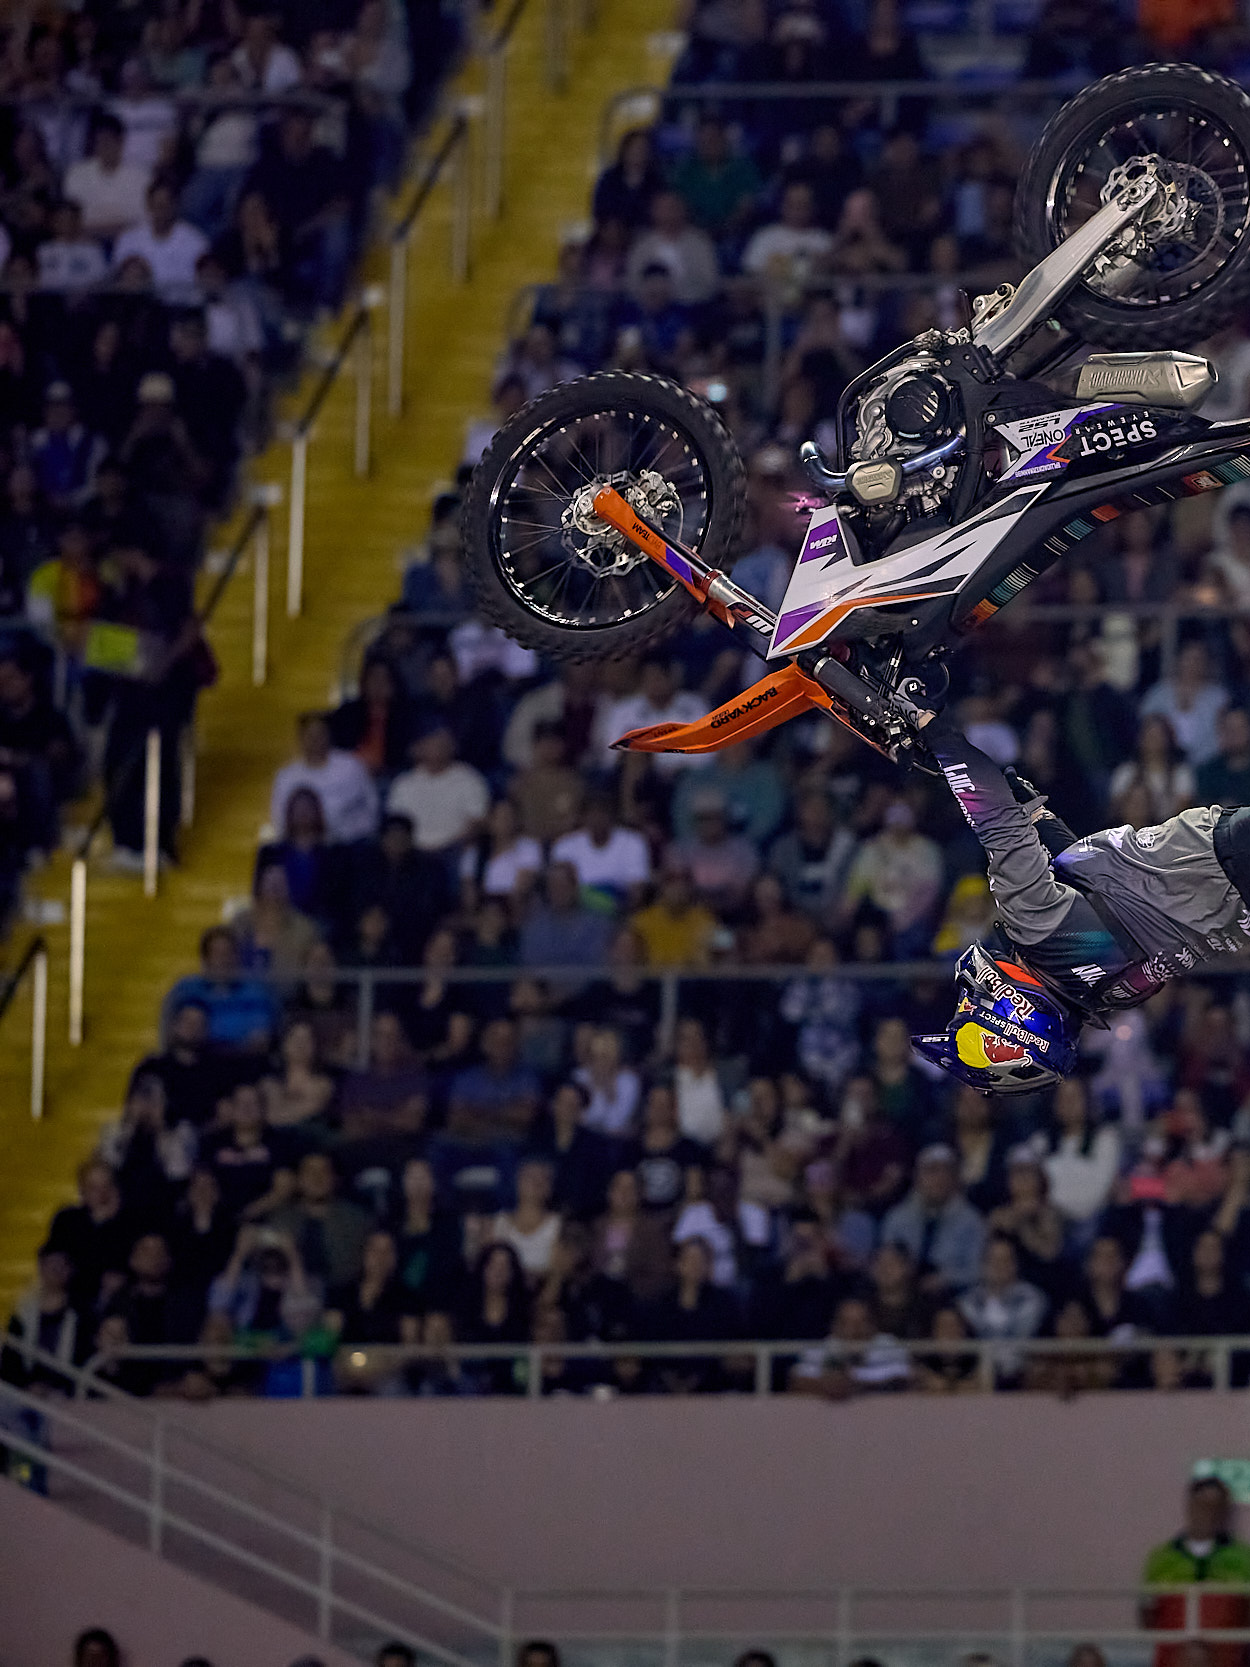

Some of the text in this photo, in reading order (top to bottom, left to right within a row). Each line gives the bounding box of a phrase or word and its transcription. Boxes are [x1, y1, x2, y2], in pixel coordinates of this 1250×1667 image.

[1080, 420, 1157, 457] SPECT
[809, 534, 838, 550] KTM
[710, 686, 778, 729] BACKYARD
[978, 1010, 1007, 1028] SPECT
